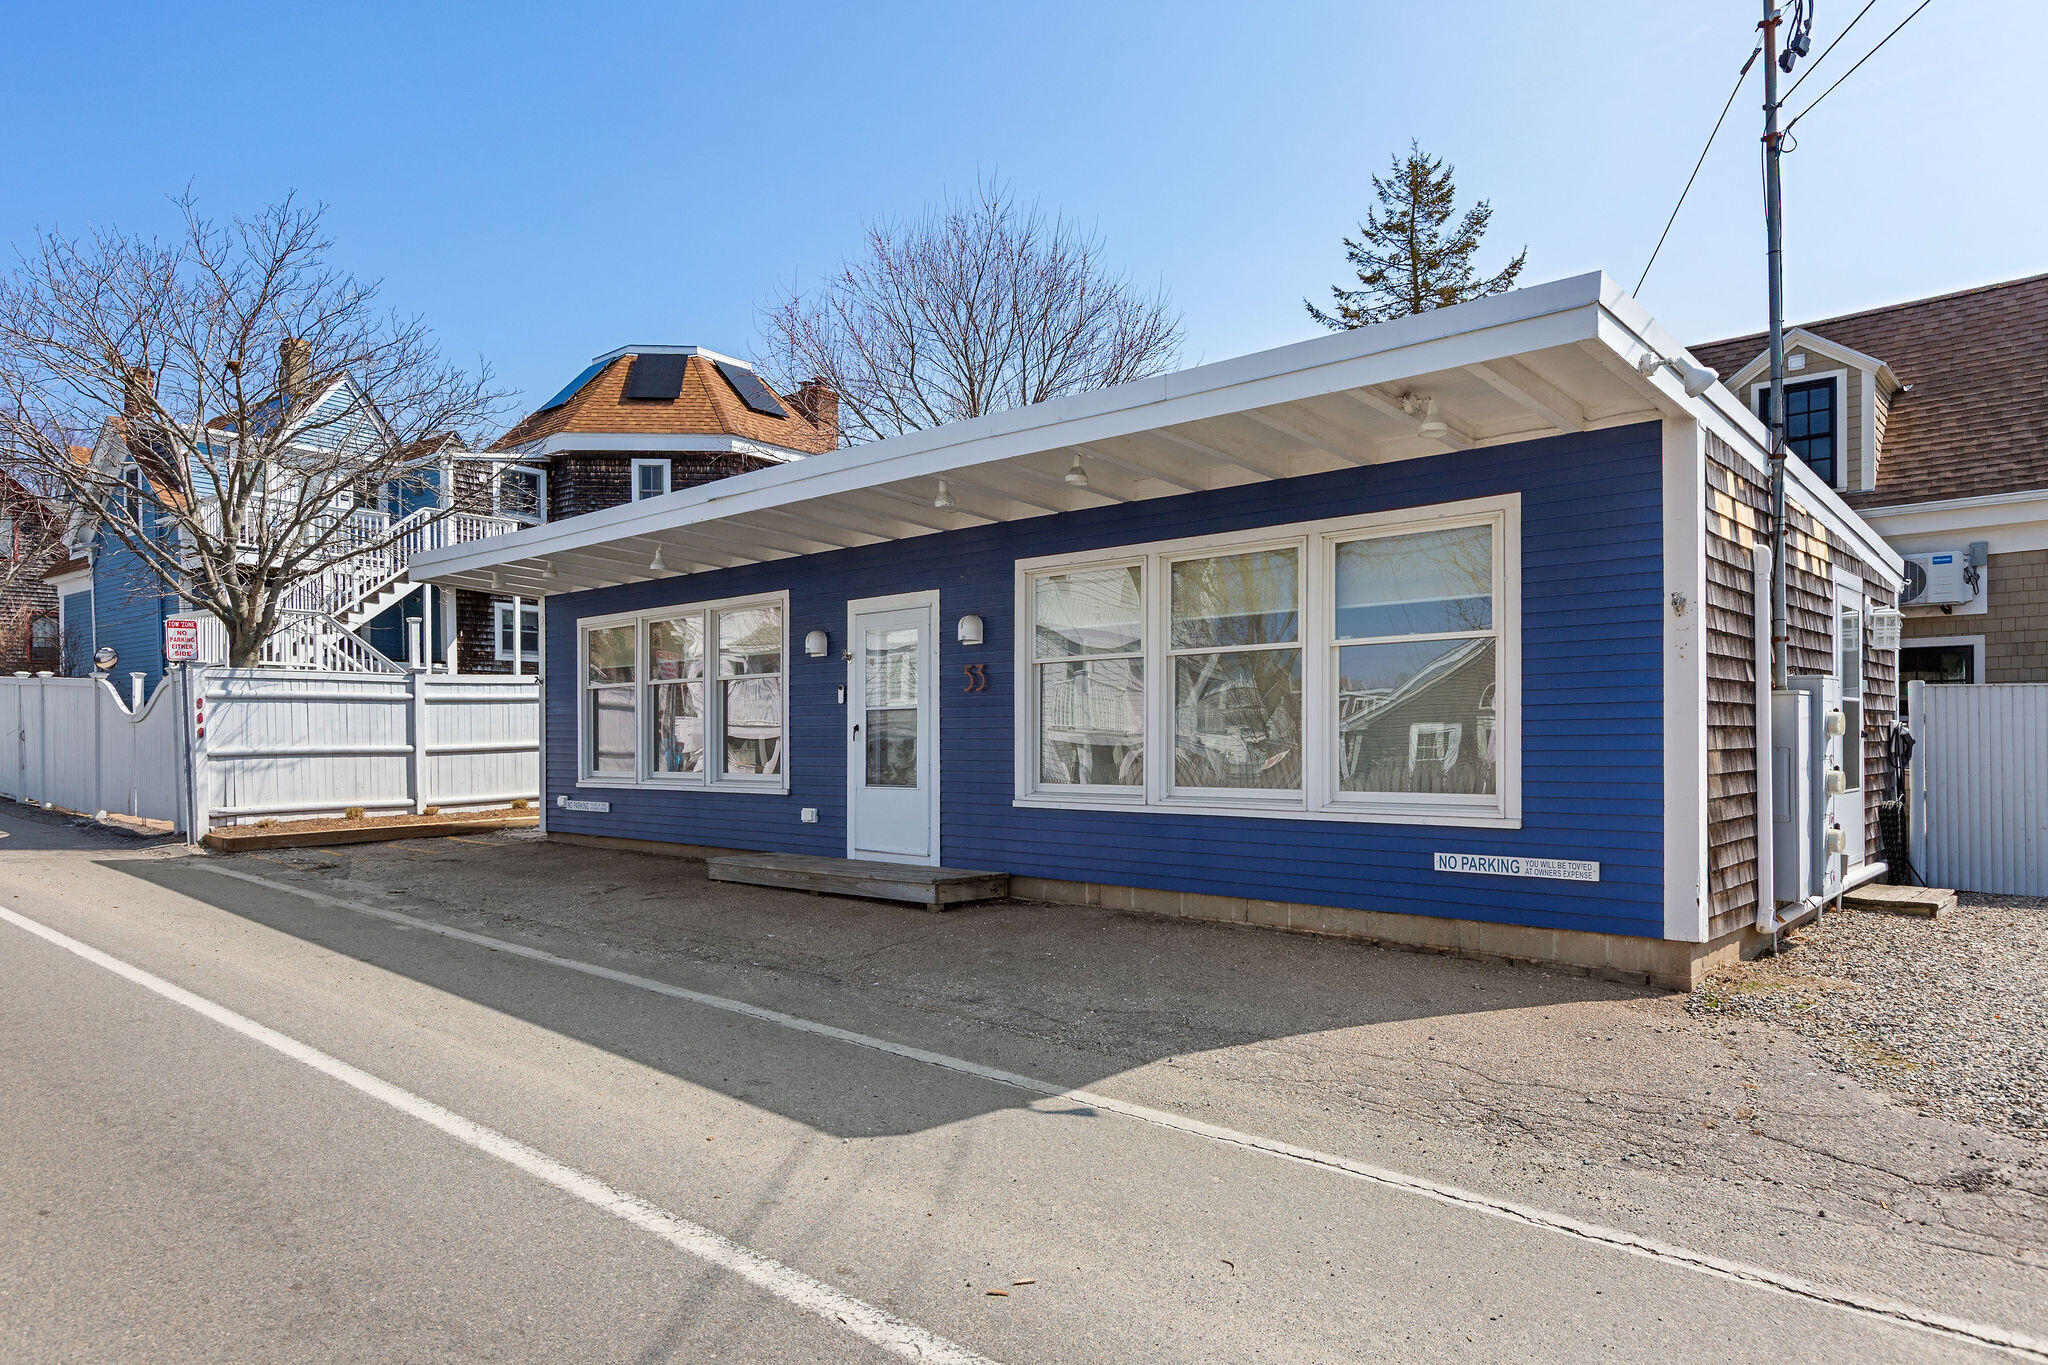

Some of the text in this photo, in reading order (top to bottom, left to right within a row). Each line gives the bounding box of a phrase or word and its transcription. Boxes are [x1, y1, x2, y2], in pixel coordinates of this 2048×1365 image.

[963, 664, 985, 692] 53
[573, 801, 589, 810] PARKING
[1438, 854, 1521, 875] NO PARKING
[1525, 859, 1593, 871] YOU WILL BE TOWED
[1534, 868, 1562, 878] OWNERS
[1563, 869, 1593, 880] EXPENSE
